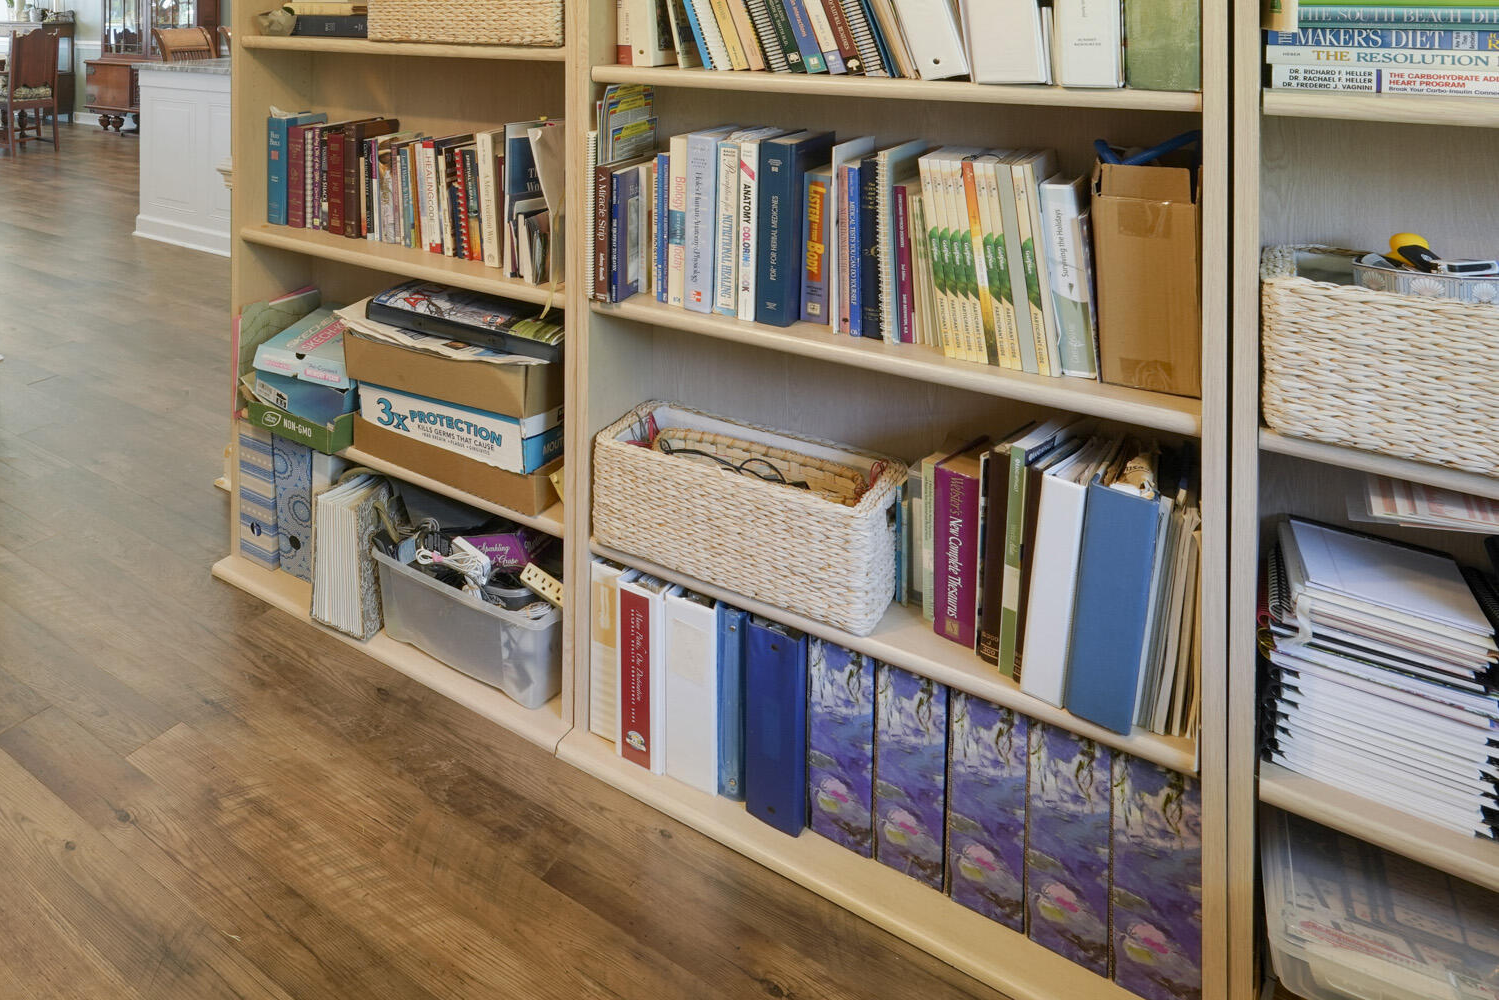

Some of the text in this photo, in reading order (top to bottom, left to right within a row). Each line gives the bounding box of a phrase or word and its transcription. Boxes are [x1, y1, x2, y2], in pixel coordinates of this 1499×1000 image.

[1403, 9, 1461, 23] BEACH
[1297, 29, 1444, 48] MAKER'S DIET
[1312, 50, 1490, 66] THE RESOLUTION
[1408, 73, 1480, 81] CARBOHYDRATE
[722, 159, 736, 199] Prescription
[598, 184, 606, 217] Miracle
[722, 200, 736, 212] for
[596, 220, 606, 241] Strip
[672, 176, 686, 271] Biology Today
[692, 191, 702, 283] Human Anatomy Physiology
[722, 214, 734, 262] NUTRITIONAL
[742, 184, 751, 267] ANATOMY COLORING
[770, 195, 778, 264] FOR HERBAL MEDICINES
[806, 185, 827, 274] LISTEN BODY
[1054, 209, 1069, 278] Surviving the Holidays
[720, 264, 733, 298] HEALING
[939, 298, 947, 330] PARTICIPANT
[950, 299, 959, 332] PARTICIPANT
[961, 302, 969, 333] PARTICIPANT
[973, 302, 981, 334] PARTICIPANT
[1033, 312, 1043, 346] PARTICIPANT
[283, 418, 312, 438] NON-GMO
[409, 409, 502, 447] PROTECTION
[417, 424, 495, 451] KILLS GERMS THAT CAUSE
[945, 477, 965, 618] Webster's New Complete Thesaurus
